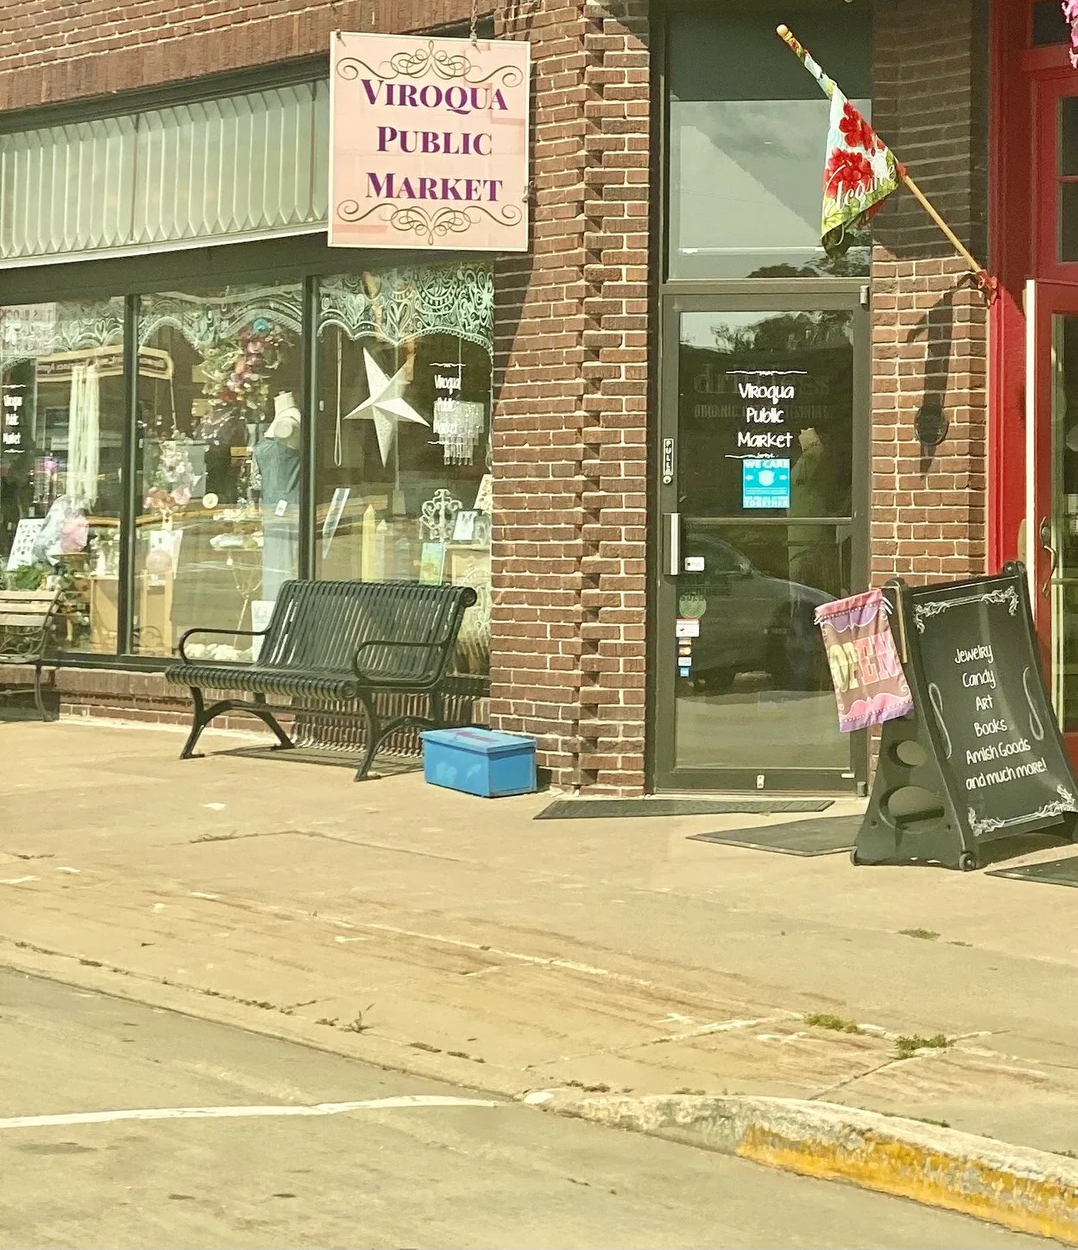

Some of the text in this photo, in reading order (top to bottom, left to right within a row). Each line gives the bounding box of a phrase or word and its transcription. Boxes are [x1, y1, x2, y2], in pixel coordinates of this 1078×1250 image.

[360, 78, 509, 115] VIROQUA
[376, 125, 493, 156] PUBLIC
[365, 172, 504, 202] MARKET
[746, 407, 785, 424] Public
[737, 431, 793, 448] Market
[830, 629, 901, 693] OPEN
[962, 669, 996, 689] Candy
[974, 718, 1008, 738] Books
[965, 737, 1032, 765] Amish Goods
[965, 771, 988, 791] and
[986, 765, 1016, 785] much
